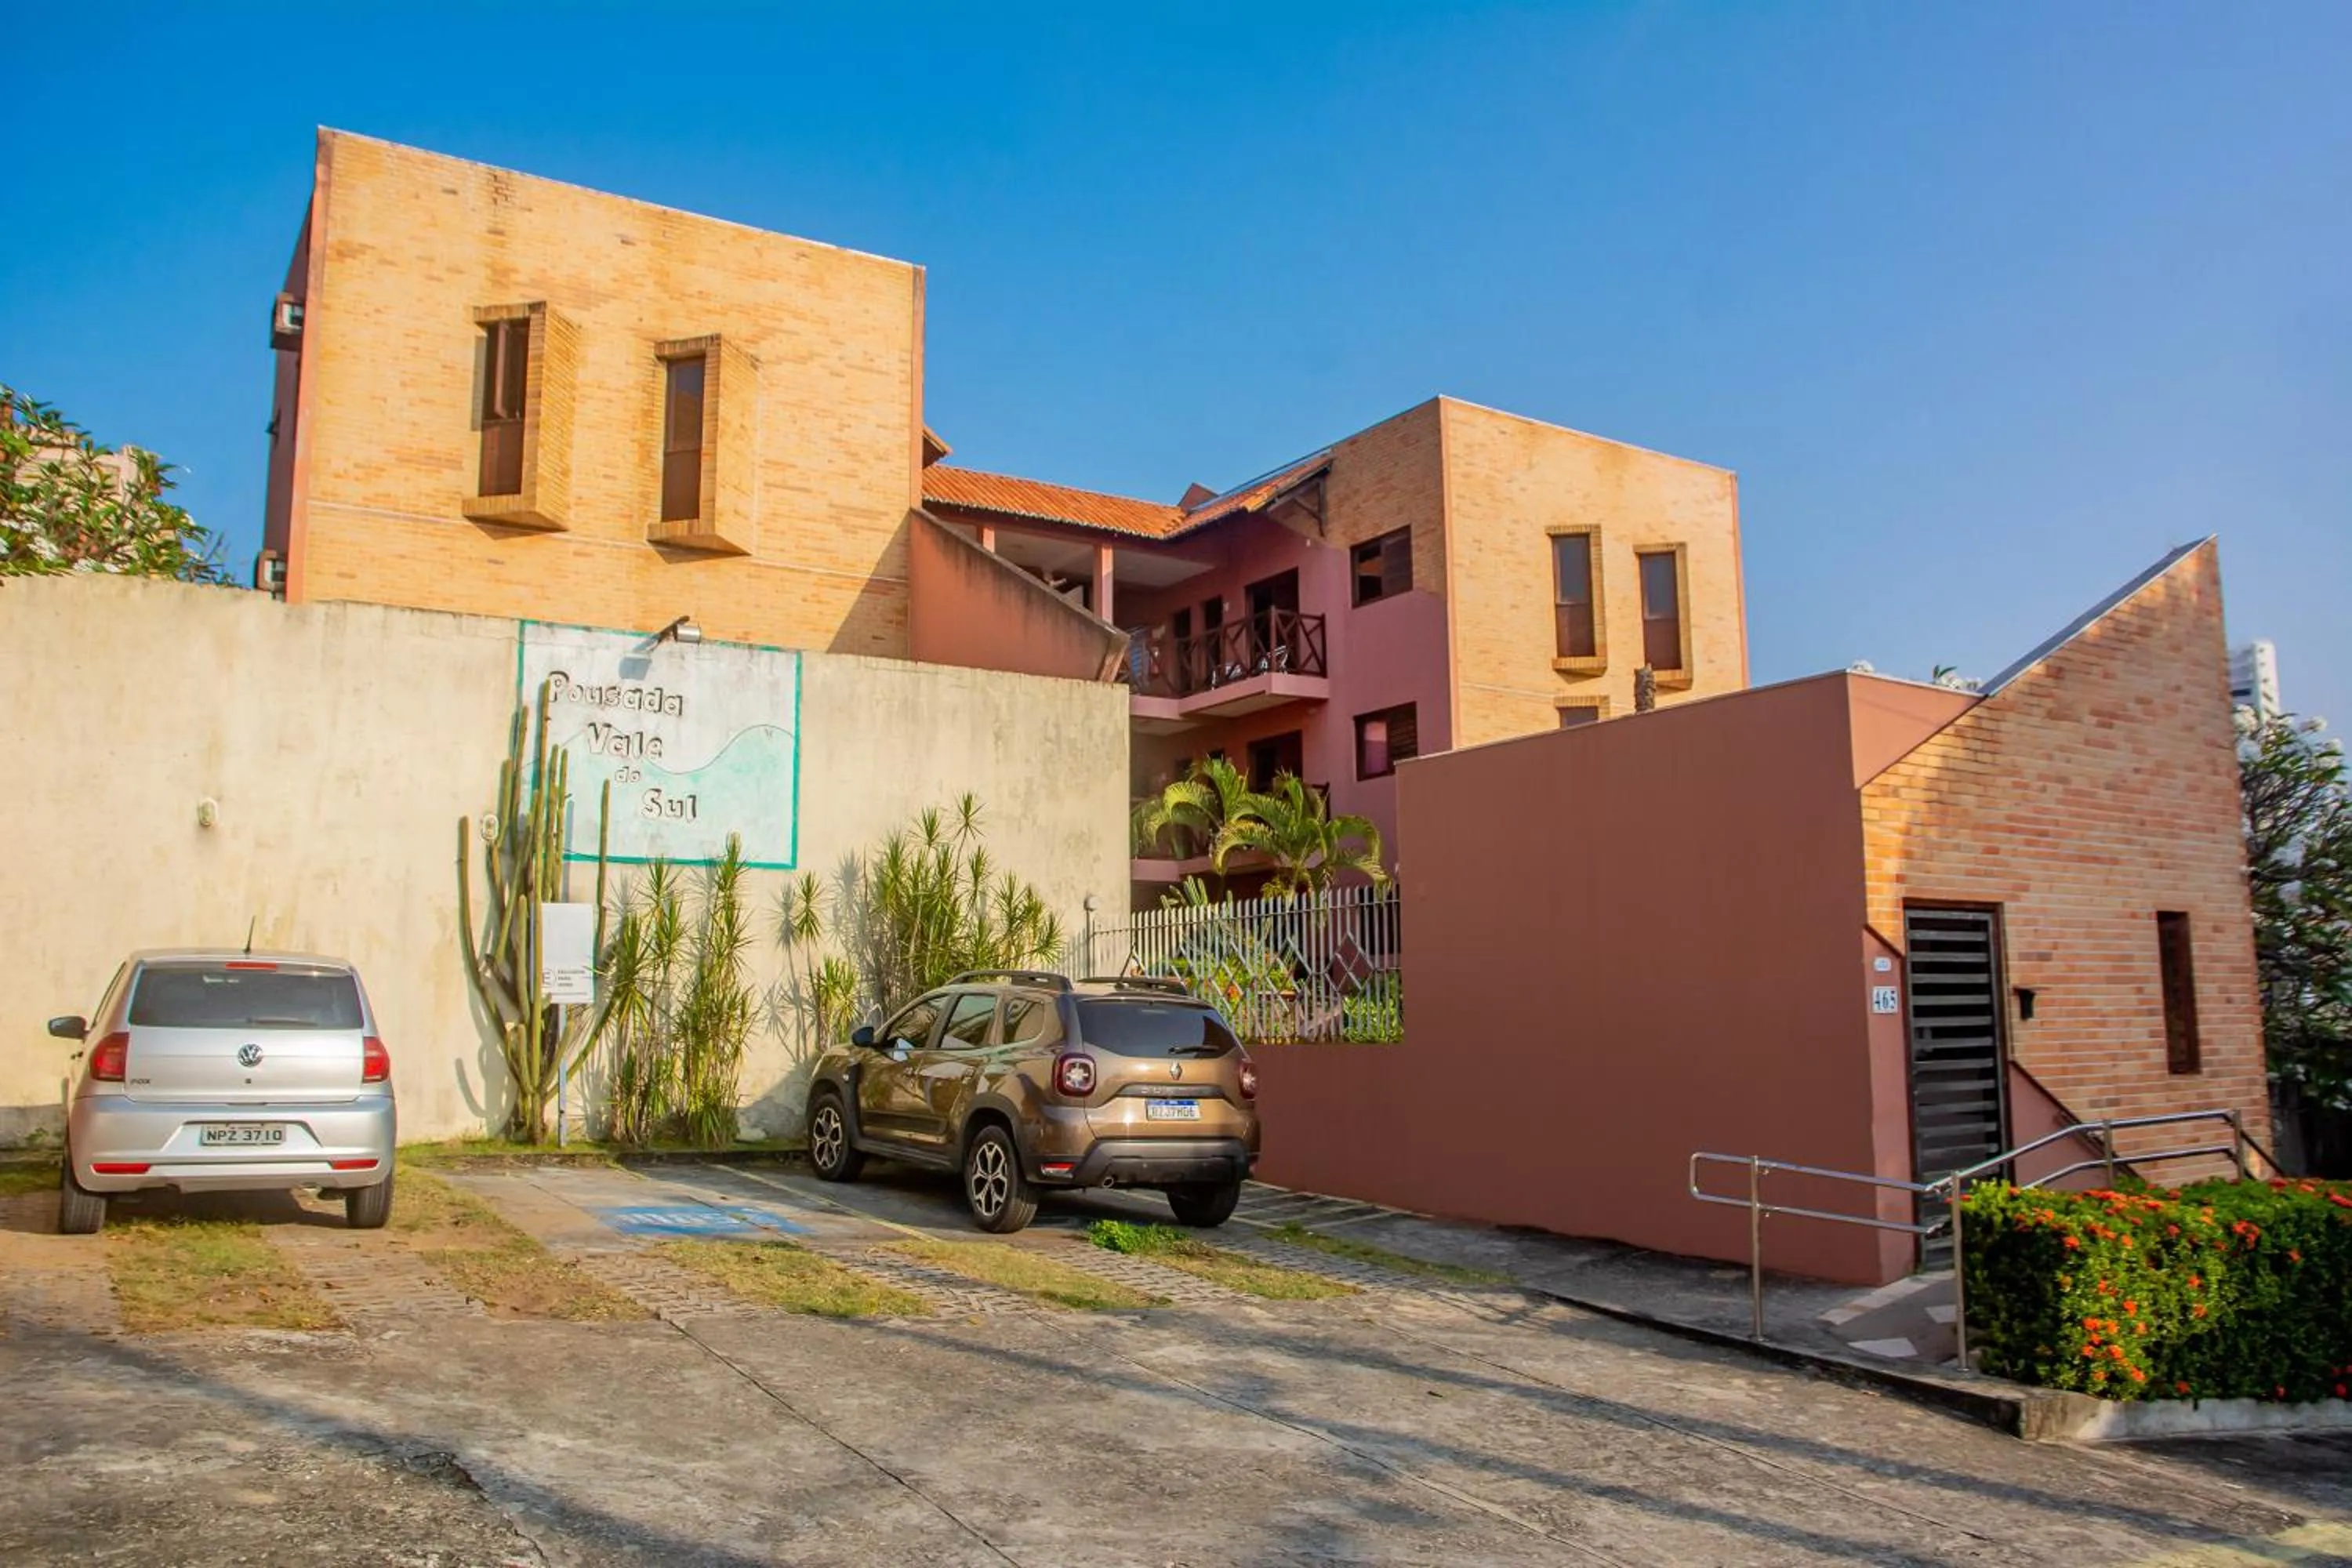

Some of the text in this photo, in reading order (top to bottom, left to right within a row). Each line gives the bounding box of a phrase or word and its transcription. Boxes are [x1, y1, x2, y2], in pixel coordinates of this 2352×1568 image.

[549, 670, 683, 716] Pousada
[587, 722, 662, 759] Vale
[614, 765, 641, 783] do
[641, 787, 697, 822] Sul
[1875, 989, 1896, 1011] 465
[206, 1130, 282, 1141] NPZ 3710
